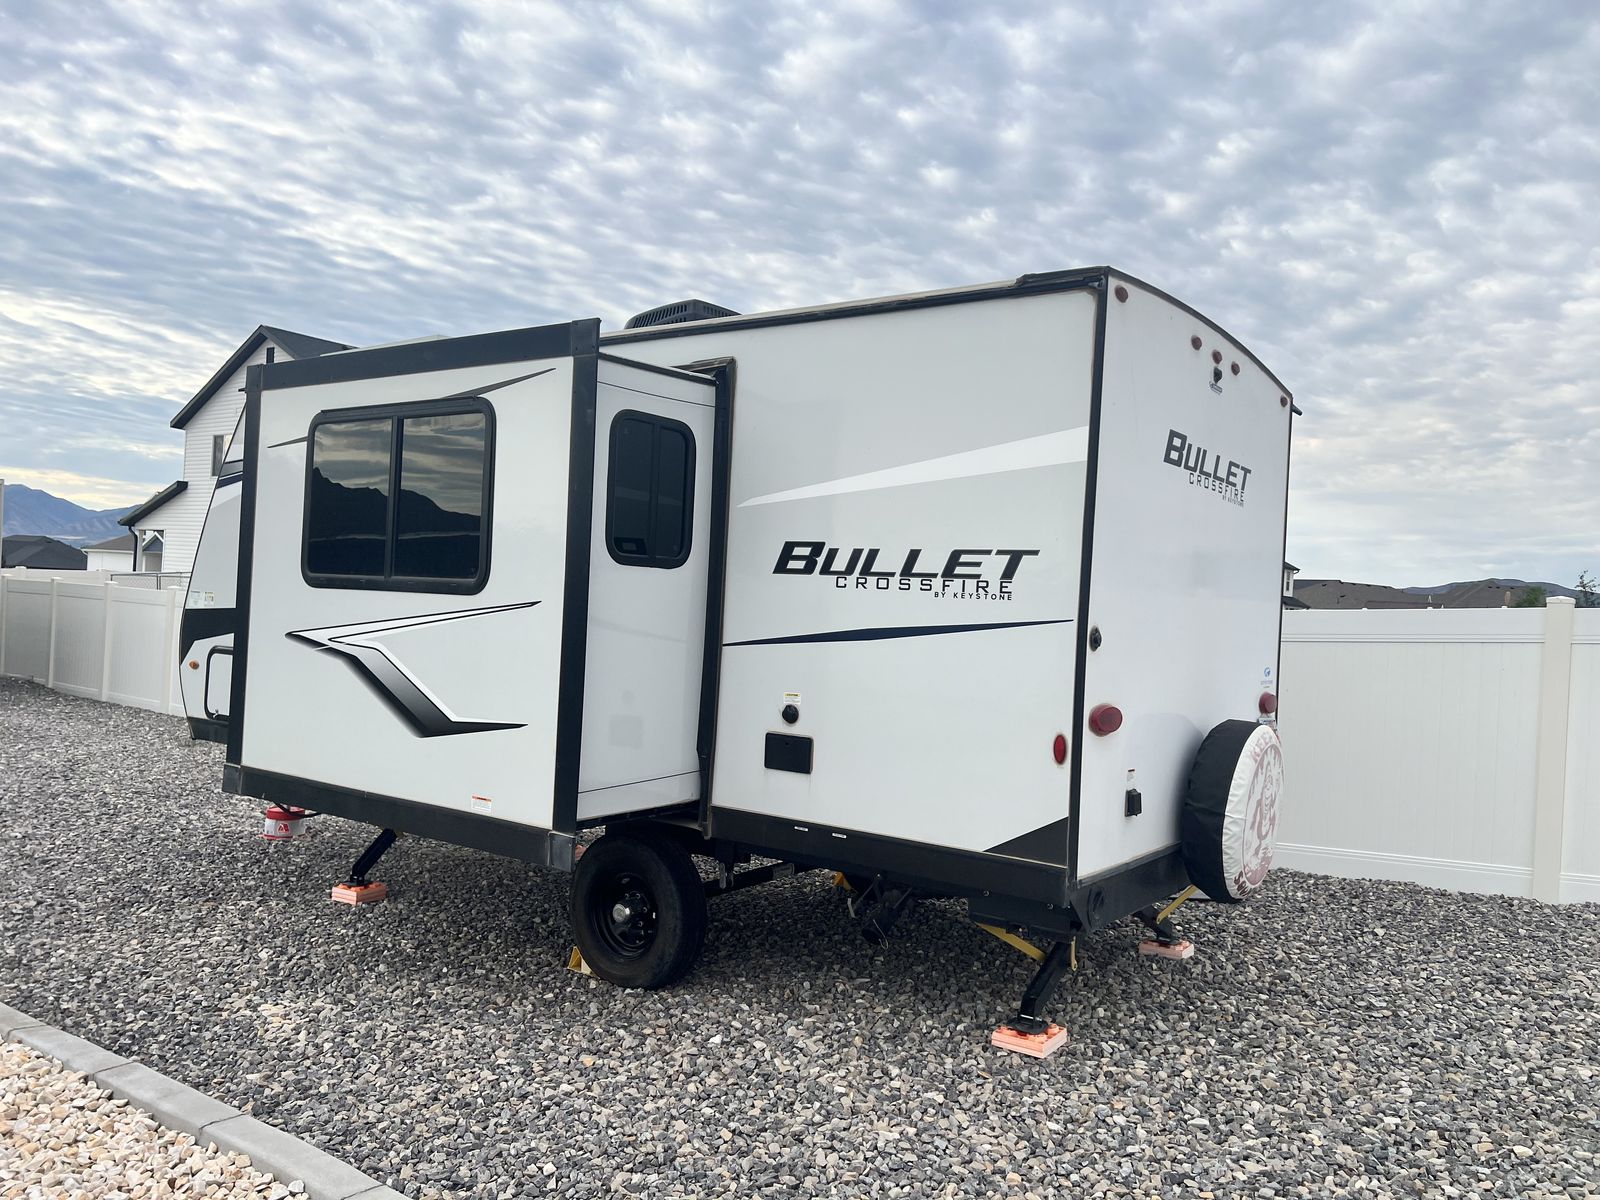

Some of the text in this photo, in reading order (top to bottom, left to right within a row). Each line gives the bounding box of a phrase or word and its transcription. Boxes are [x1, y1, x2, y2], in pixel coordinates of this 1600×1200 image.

[1163, 428, 1252, 492] BULLET
[1188, 472, 1245, 502] CROSSFIRE
[772, 541, 1040, 580] BULLET
[835, 576, 1013, 594] CROSSFIRE
[953, 592, 1012, 601] KEYSTONE
